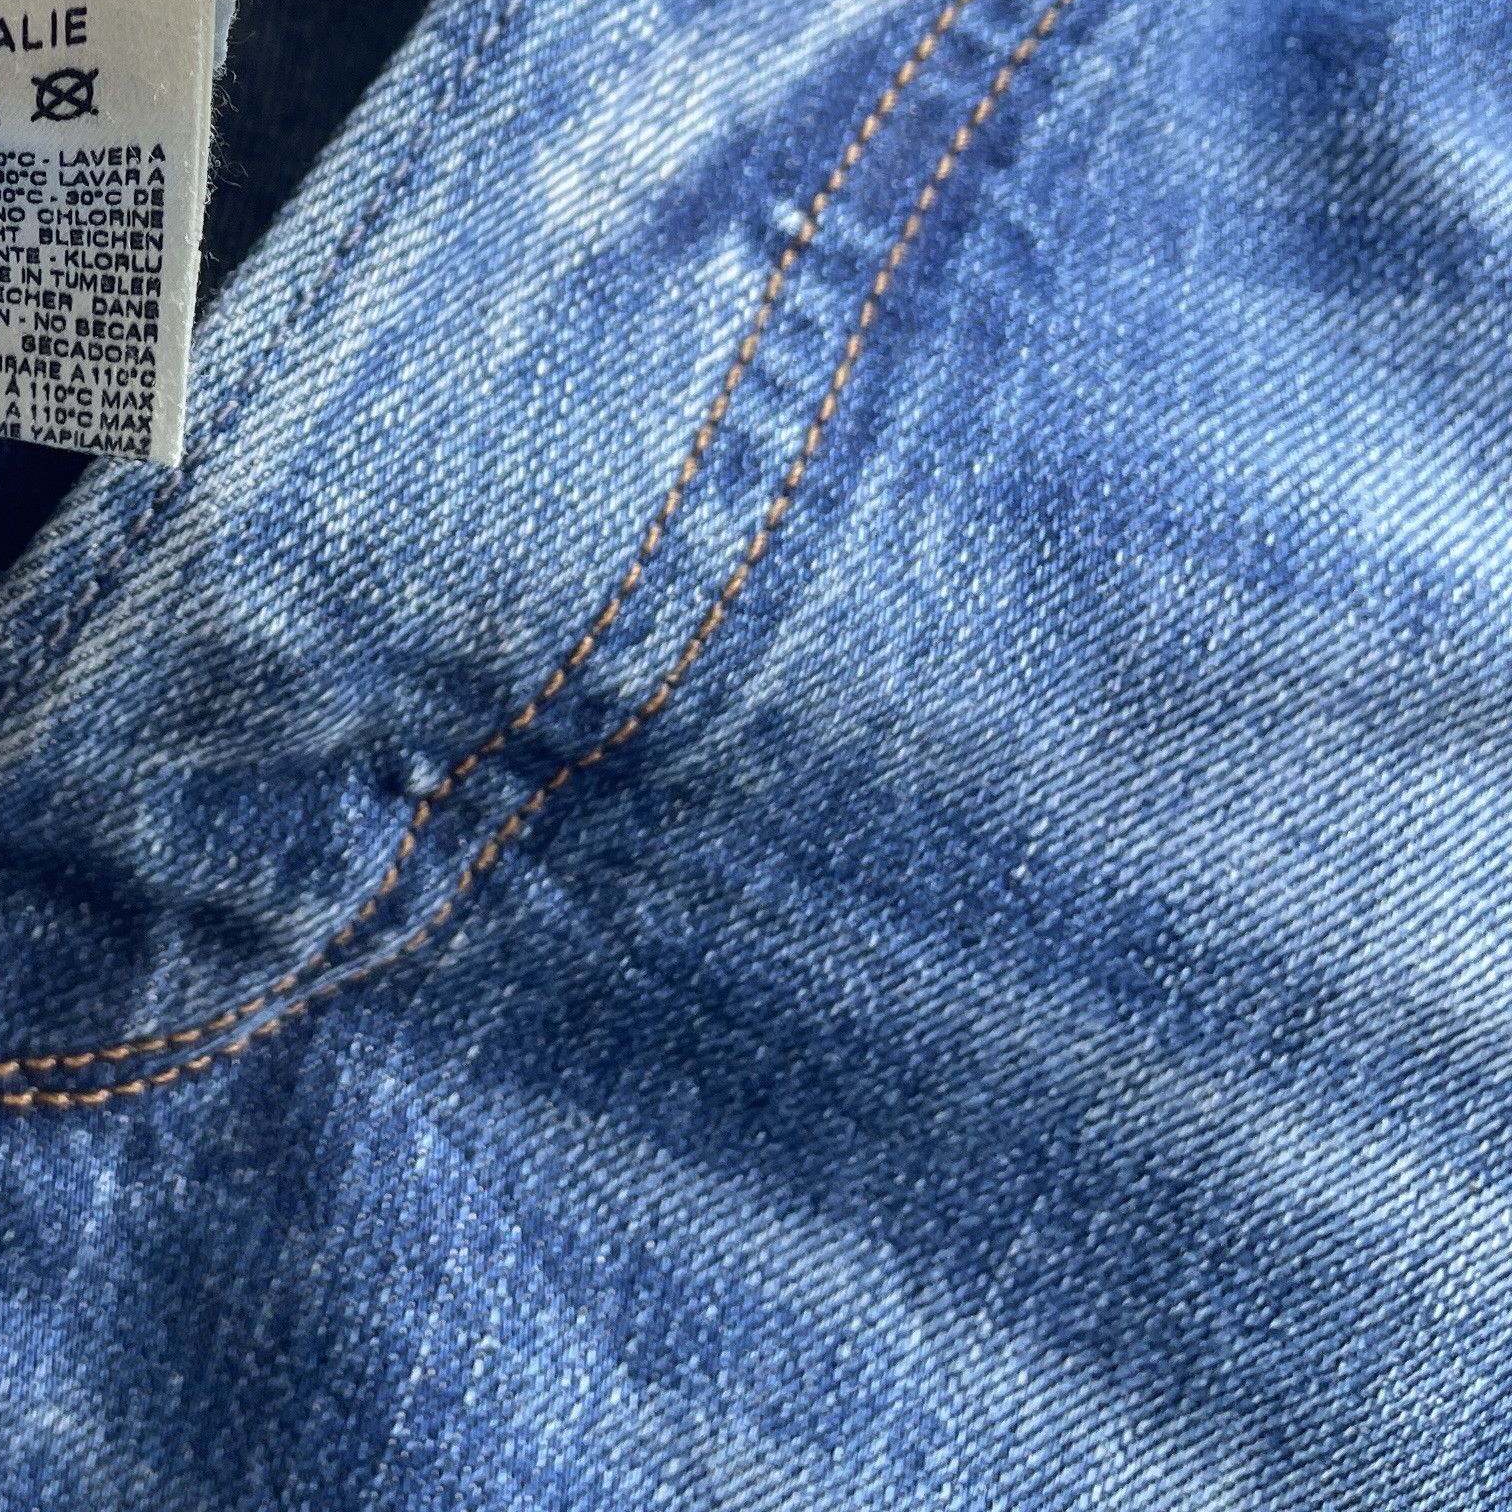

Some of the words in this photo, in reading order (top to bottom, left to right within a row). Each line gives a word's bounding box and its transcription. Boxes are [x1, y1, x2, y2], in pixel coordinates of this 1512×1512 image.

[58, 146, 141, 167] LAVER
[58, 168, 141, 186] LAVAR
[133, 188, 164, 207] DE
[37, 208, 164, 229] CHLORINE
[38, 227, 164, 251] BLEICHEN
[64, 249, 163, 273] KLORLU
[21, 267, 42, 286] IN
[50, 269, 161, 297] TUMBLER
[92, 296, 160, 320] DANS
[34, 311, 67, 333] NO
[75, 317, 159, 343] SECAR
[21, 334, 156, 366] SECADORA
[101, 389, 155, 413] MAX
[99, 411, 153, 433] MAX
[31, 425, 152, 456] YAPILAMAZ
